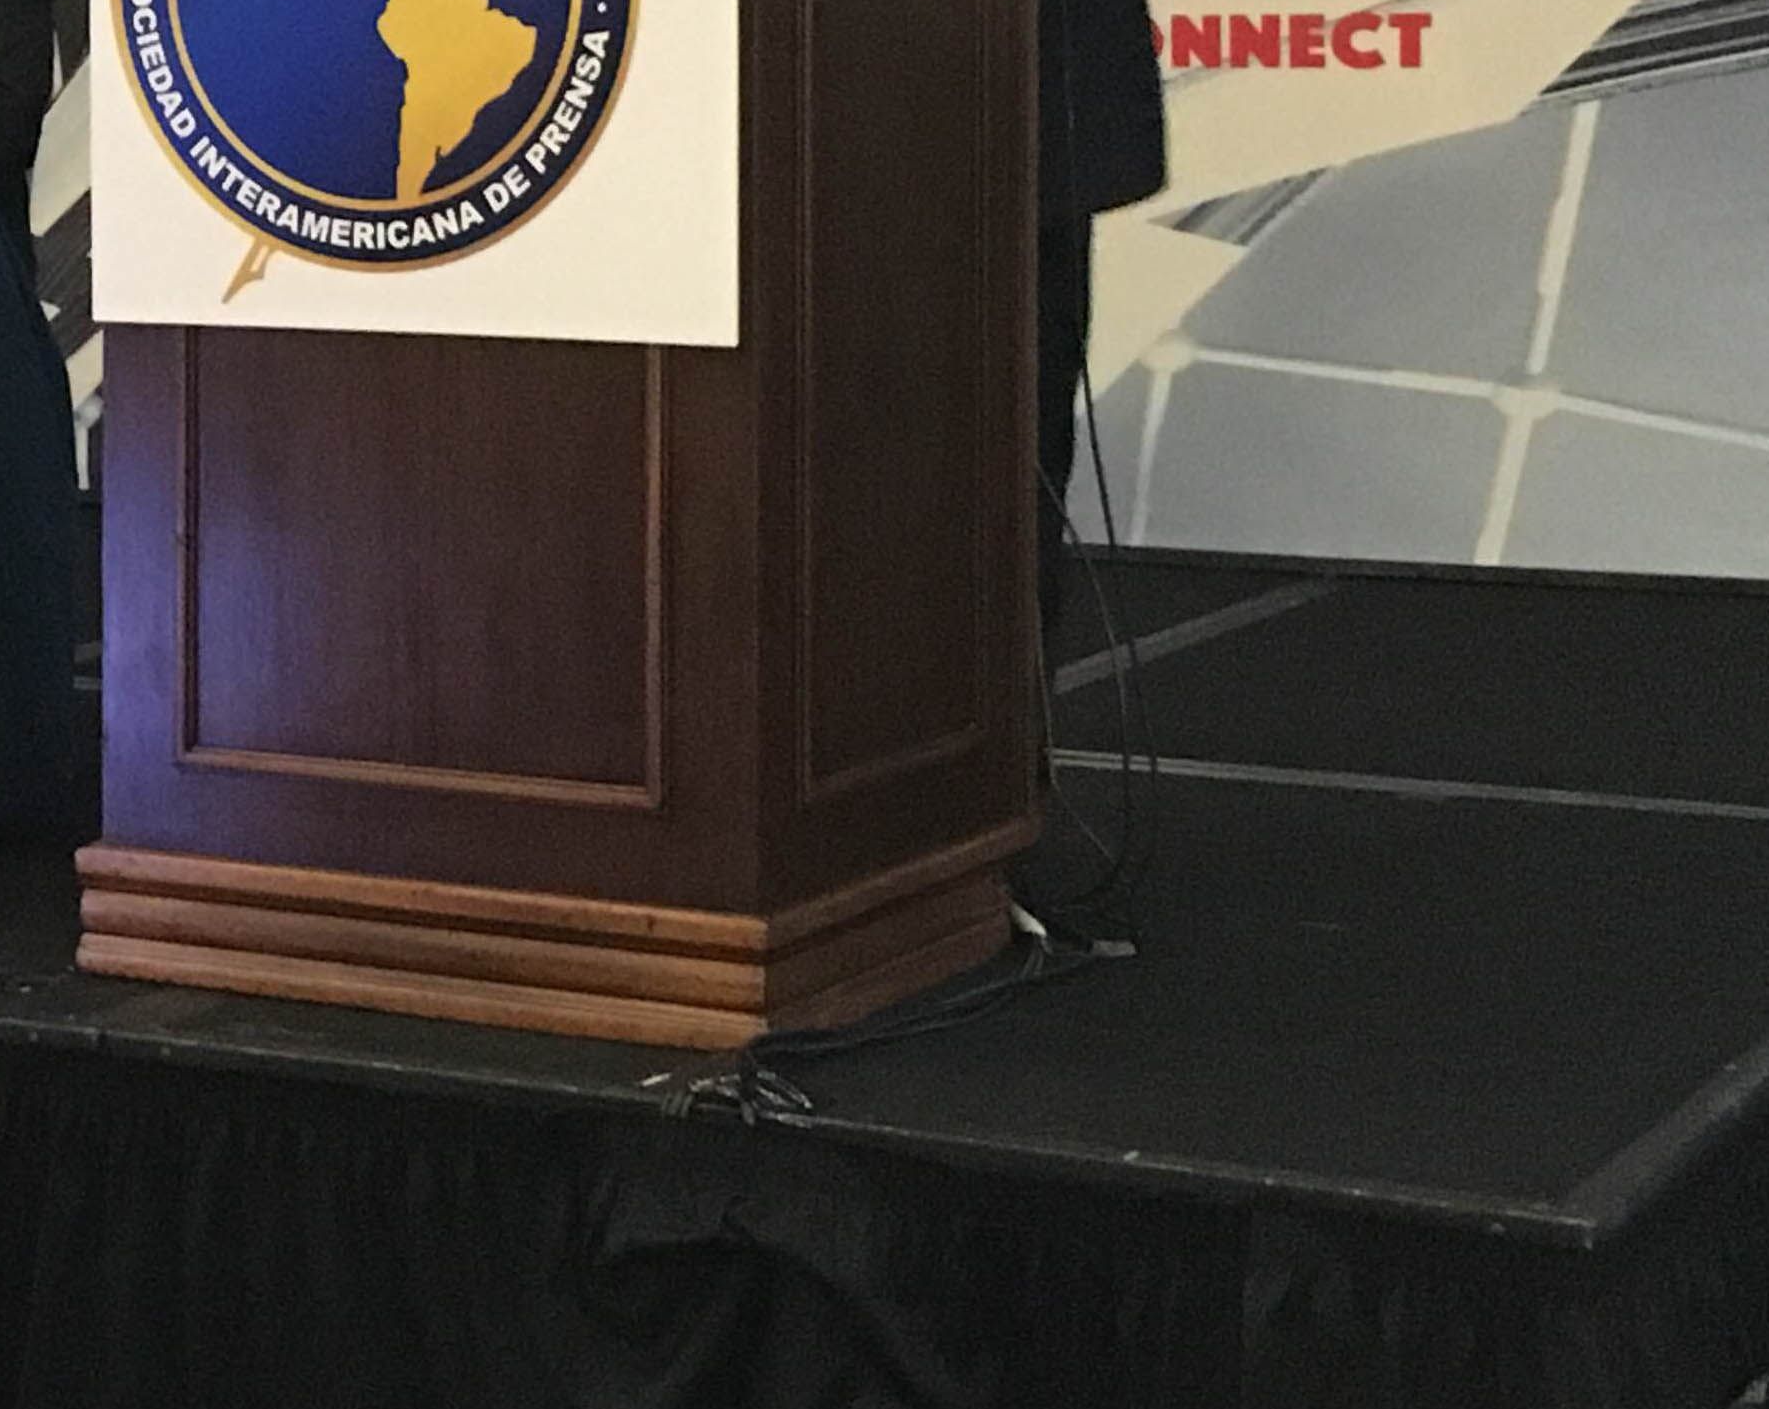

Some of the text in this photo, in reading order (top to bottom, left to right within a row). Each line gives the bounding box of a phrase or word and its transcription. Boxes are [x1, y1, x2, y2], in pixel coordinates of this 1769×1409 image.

[1151, 12, 1433, 69] NNECT
[189, 136, 485, 252] INTERAMERICANA
[484, 166, 531, 212] DE
[523, 29, 611, 170] PRENSA
